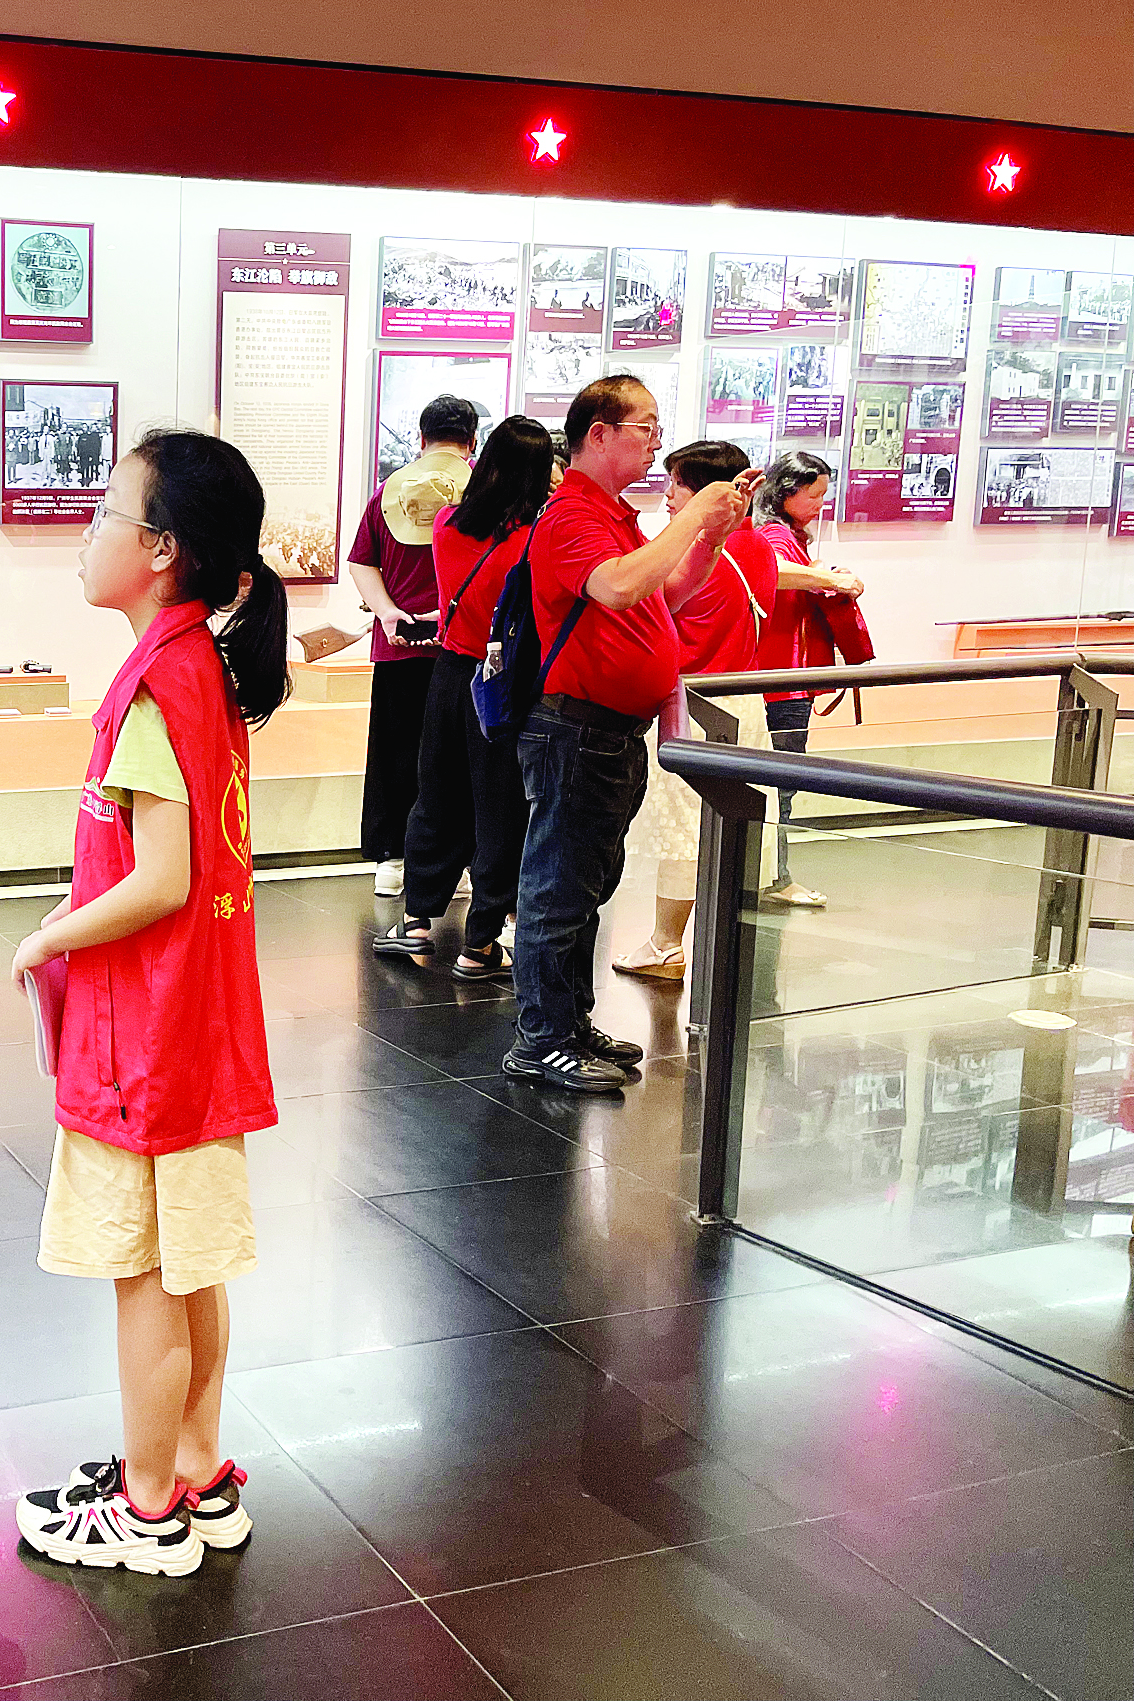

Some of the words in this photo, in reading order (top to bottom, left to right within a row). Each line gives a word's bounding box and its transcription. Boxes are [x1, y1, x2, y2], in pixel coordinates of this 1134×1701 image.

[264, 241, 309, 256] 第三单元
[230, 266, 283, 284] 东江沦陷
